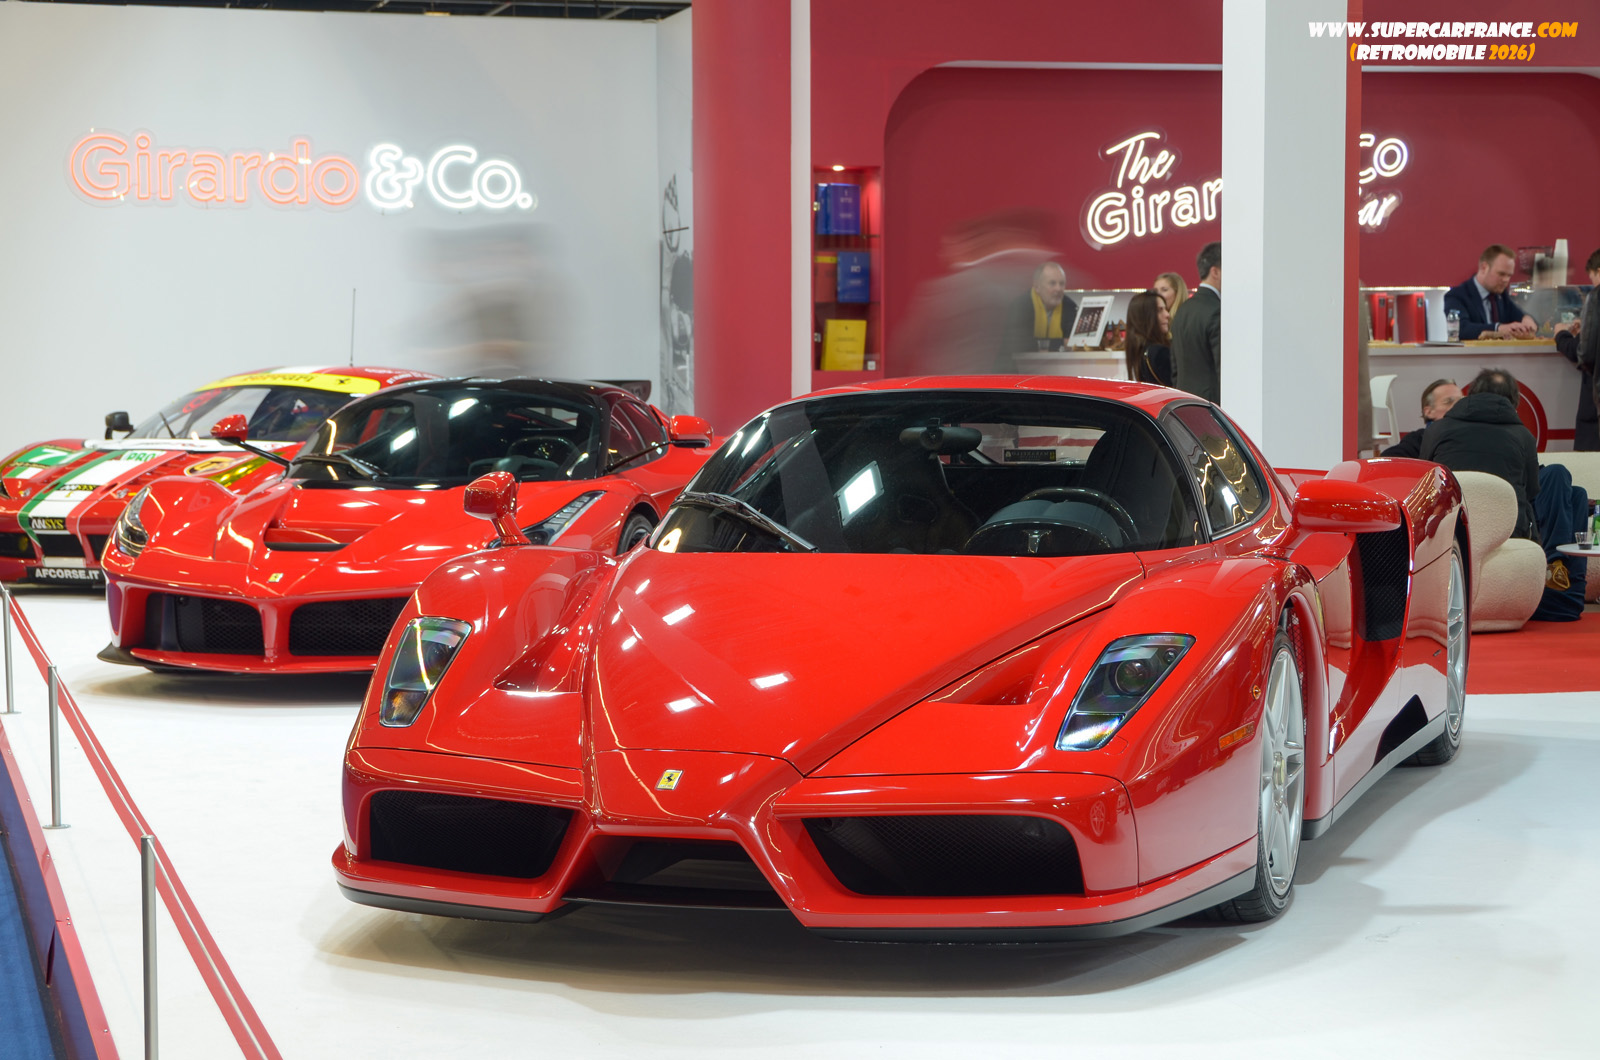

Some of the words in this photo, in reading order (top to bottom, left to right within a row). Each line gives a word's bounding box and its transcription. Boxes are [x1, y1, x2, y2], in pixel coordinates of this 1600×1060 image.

[70, 134, 360, 206] Girardo
[1106, 131, 1176, 189] The
[1086, 177, 1223, 245] Girar
[28, 448, 69, 464] 7
[31, 518, 64, 530] ANSYS
[35, 567, 100, 580] AFCORSE.IT
